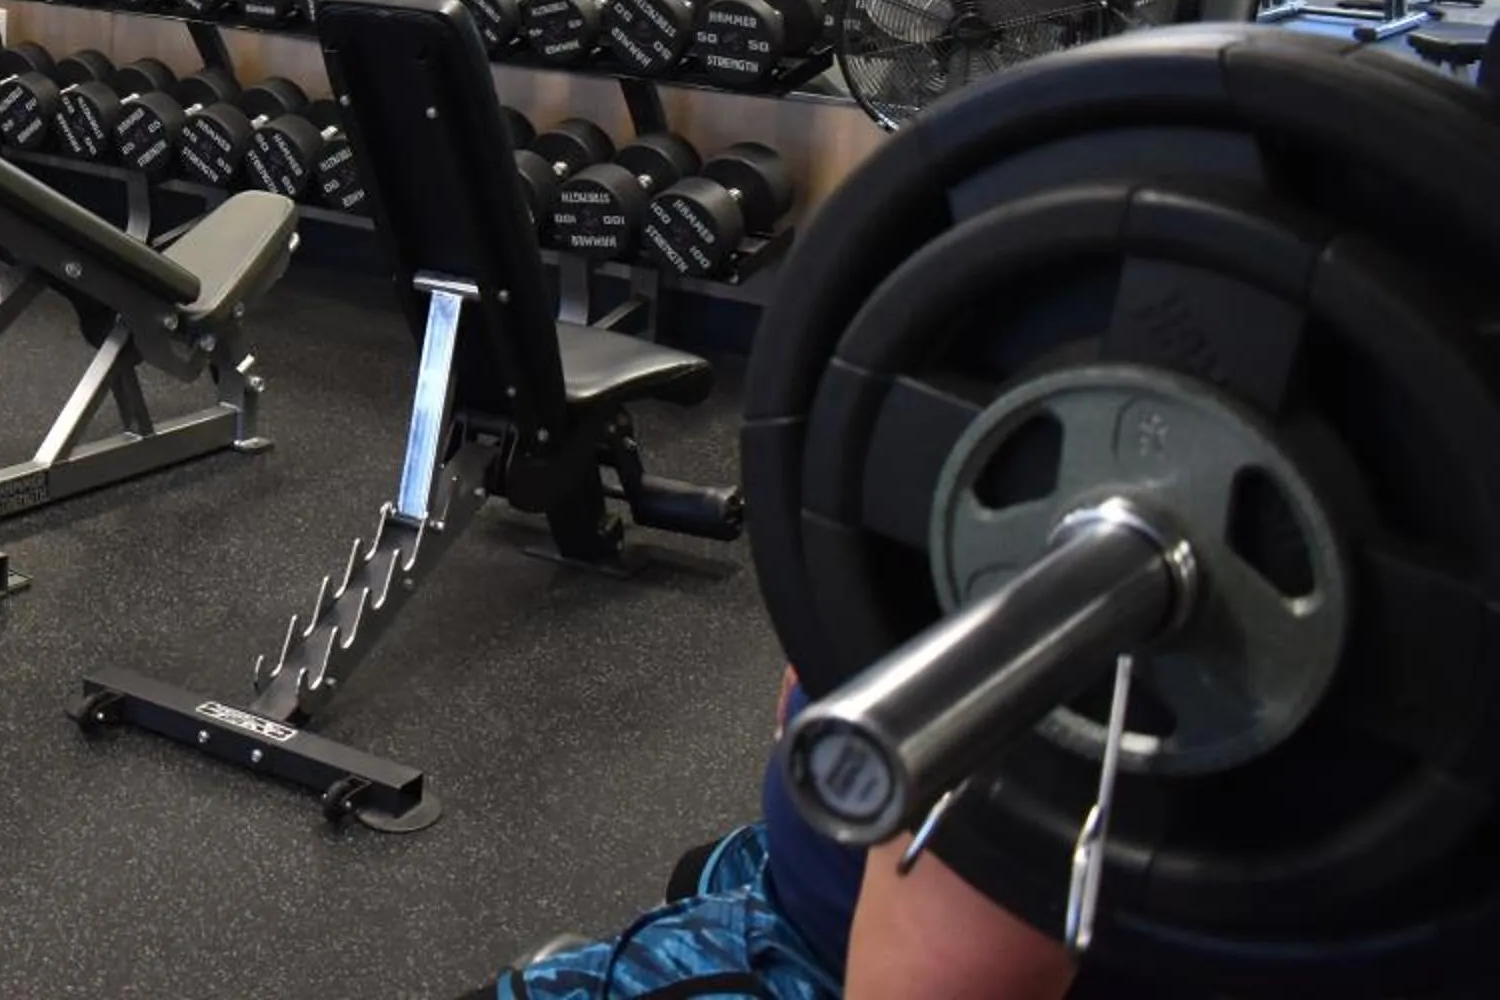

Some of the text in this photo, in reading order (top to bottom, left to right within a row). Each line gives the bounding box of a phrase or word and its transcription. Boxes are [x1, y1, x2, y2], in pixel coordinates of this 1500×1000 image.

[709, 11, 757, 29] HAMMER
[611, 28, 652, 68] HAMMER
[697, 31, 718, 44] 50
[748, 40, 769, 53] 50
[707, 55, 759, 73] STRENGTH
[196, 119, 231, 152] HAMMER
[183, 146, 219, 182] STRENGTH
[272, 132, 303, 177] HAMMER
[561, 191, 611, 204] STRENGTH
[554, 213, 577, 224] 100
[603, 215, 626, 226] 100
[651, 201, 672, 225] 100
[672, 199, 716, 245] HAMMER
[571, 234, 618, 248] HAMMER
[644, 225, 690, 273] STRENGTH
[689, 246, 712, 270] 100
